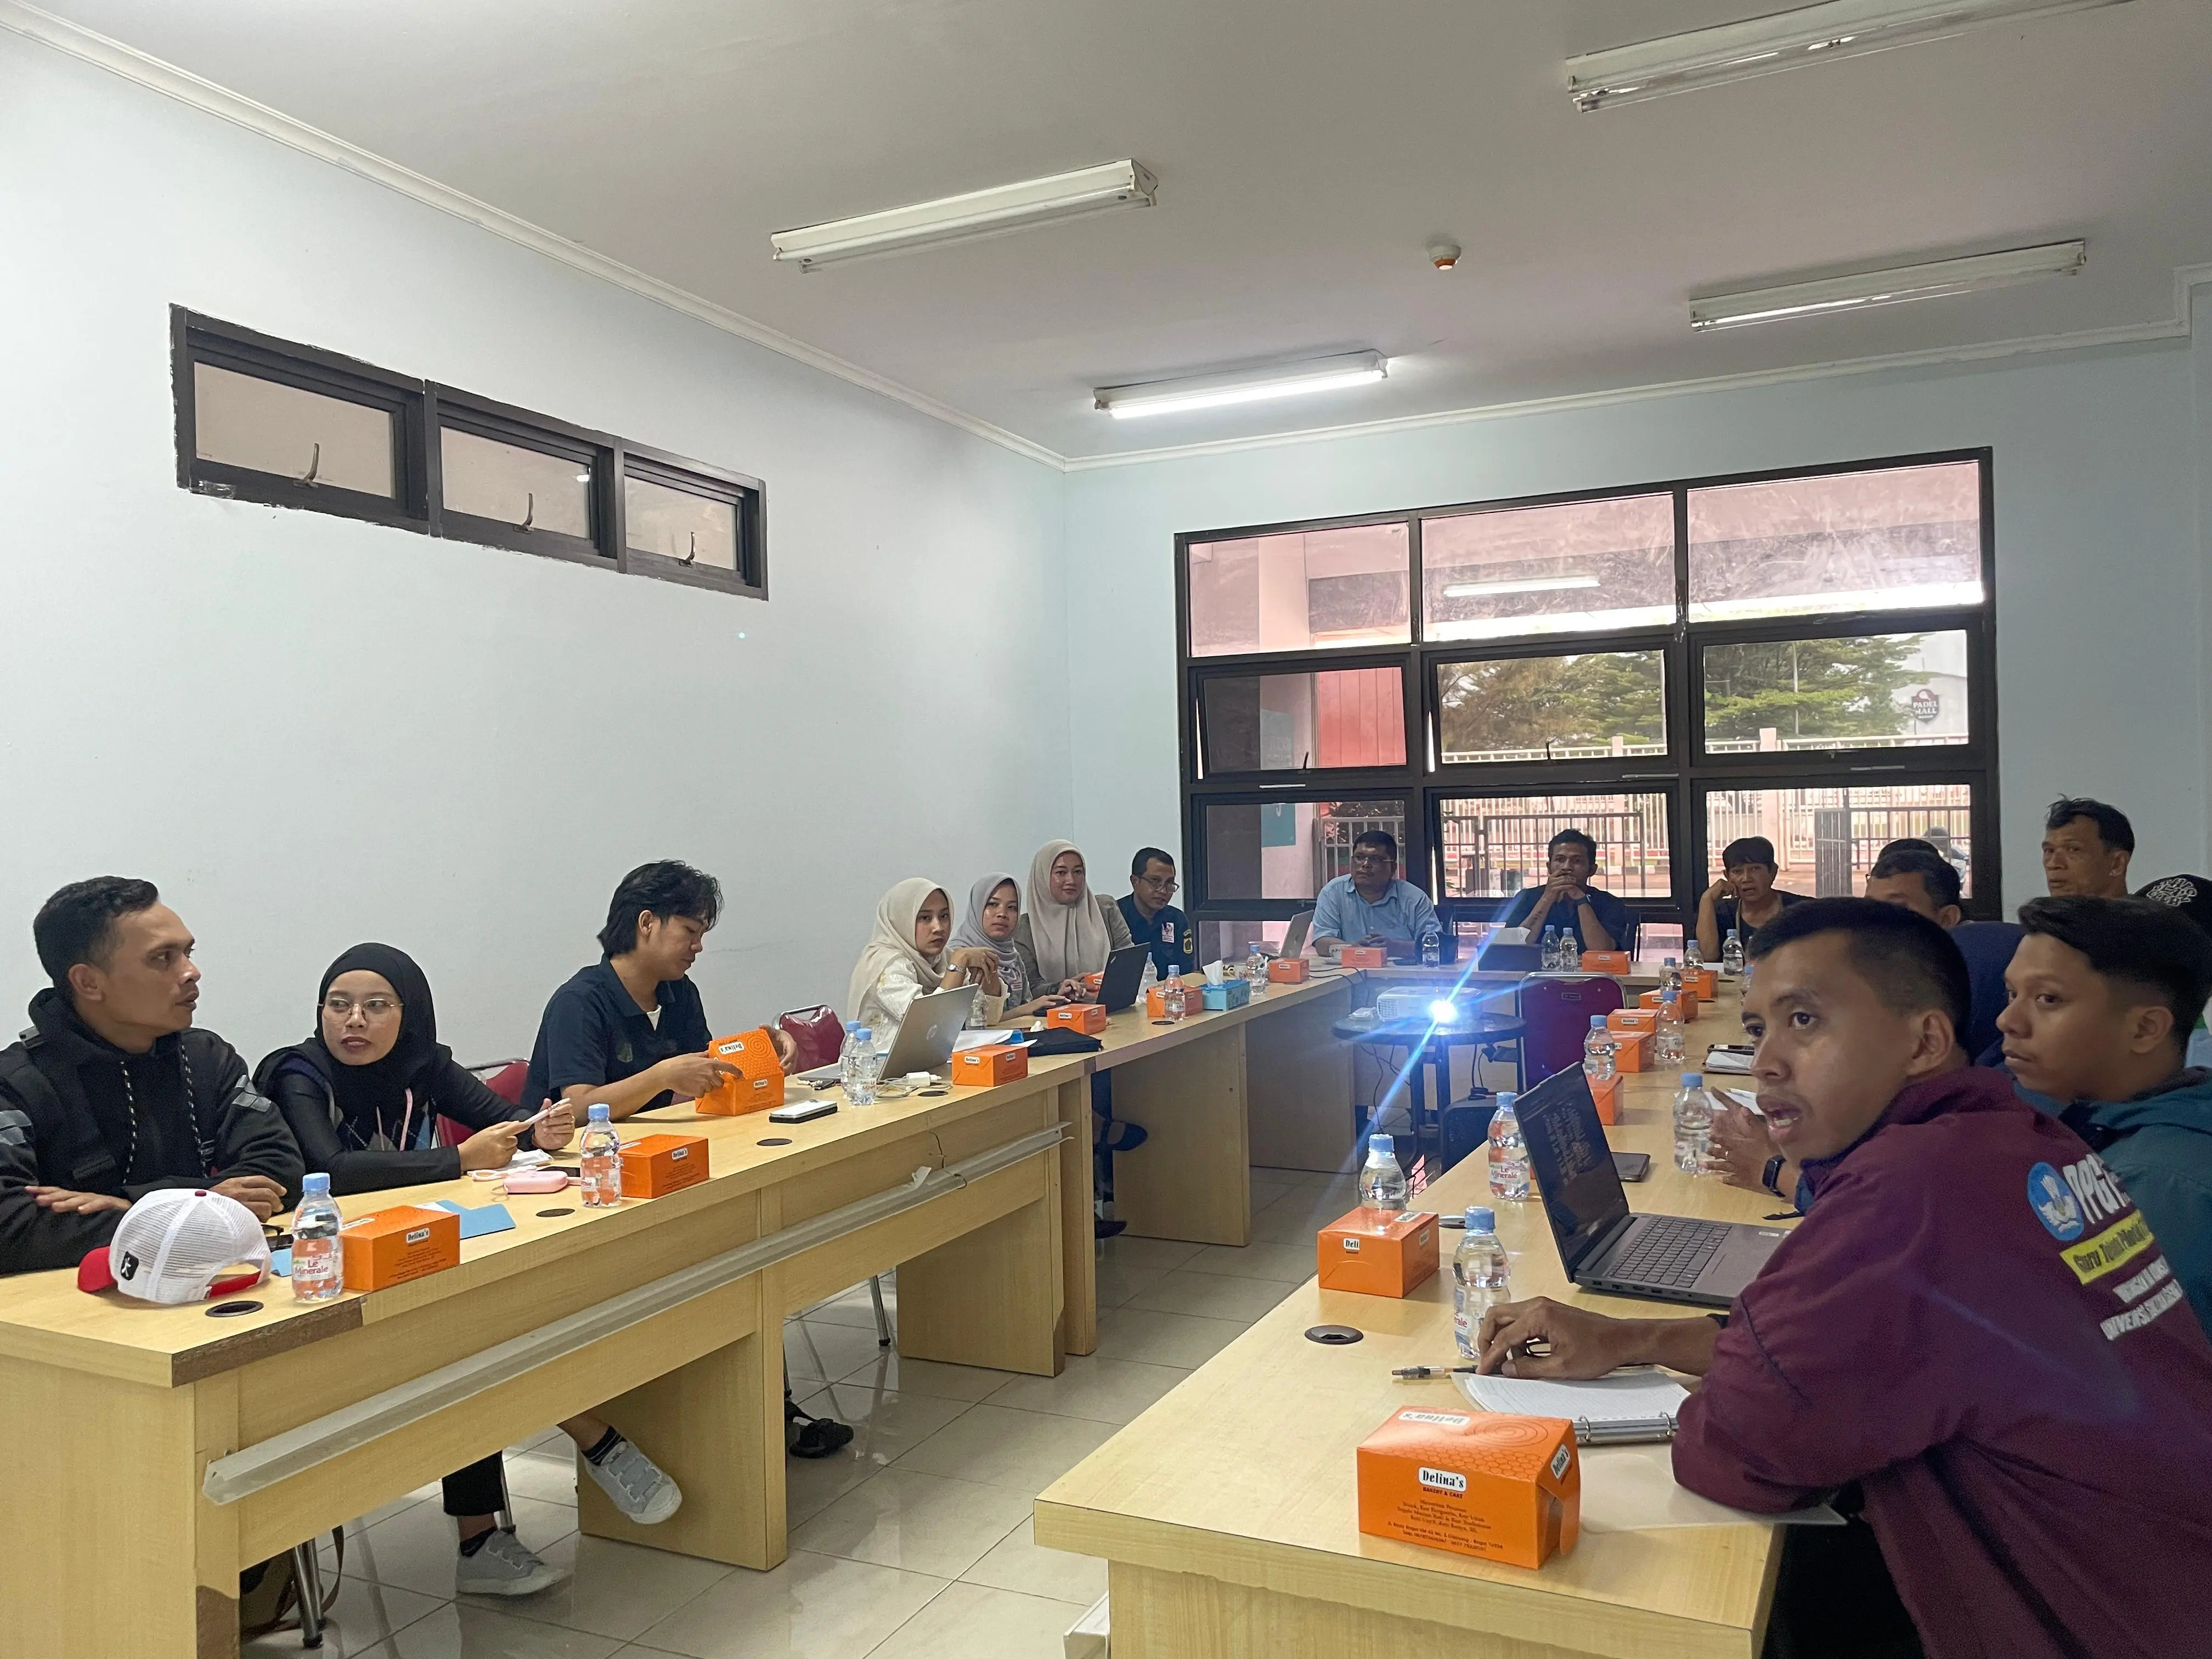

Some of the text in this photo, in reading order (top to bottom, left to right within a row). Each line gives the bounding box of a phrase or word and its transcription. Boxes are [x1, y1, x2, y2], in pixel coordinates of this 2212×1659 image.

[1492, 1171, 1517, 1179] Minerale
[407, 1229, 429, 1242] Delina's
[308, 1260, 318, 1268] Le
[295, 1266, 329, 1275] Minerale
[1423, 1470, 1464, 1488] Delina's
[1423, 1487, 1443, 1496] BAKERY
